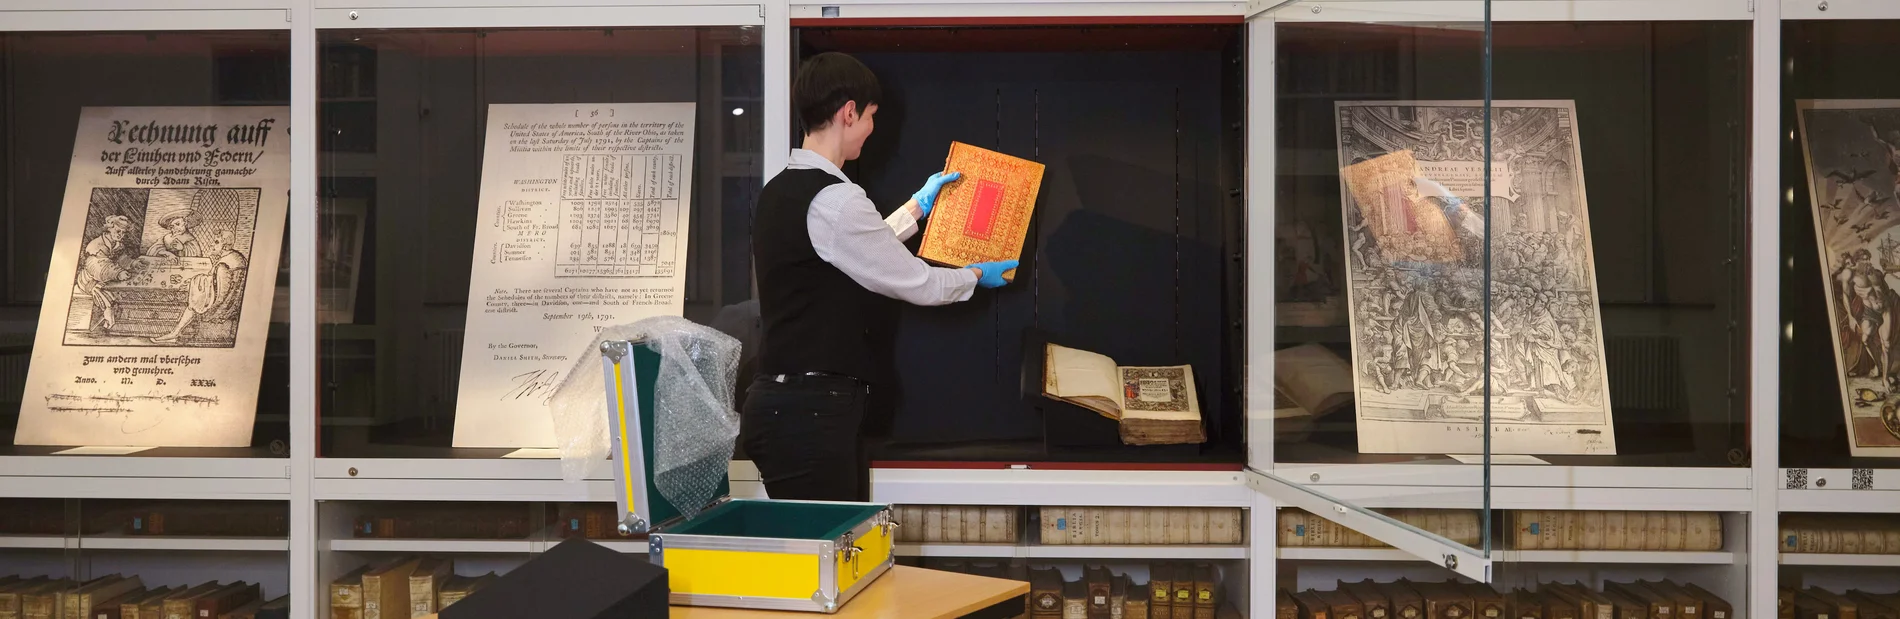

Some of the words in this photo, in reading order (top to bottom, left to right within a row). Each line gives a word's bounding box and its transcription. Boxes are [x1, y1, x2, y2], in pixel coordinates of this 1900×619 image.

[226, 118, 276, 147] auff
[510, 130, 531, 138] United
[578, 136, 593, 145] July
[101, 150, 121, 162] der
[136, 176, 160, 187] durch
[162, 176, 190, 185] Adam
[542, 313, 574, 321] September
[106, 355, 137, 364] andern
[140, 354, 158, 364] mal
